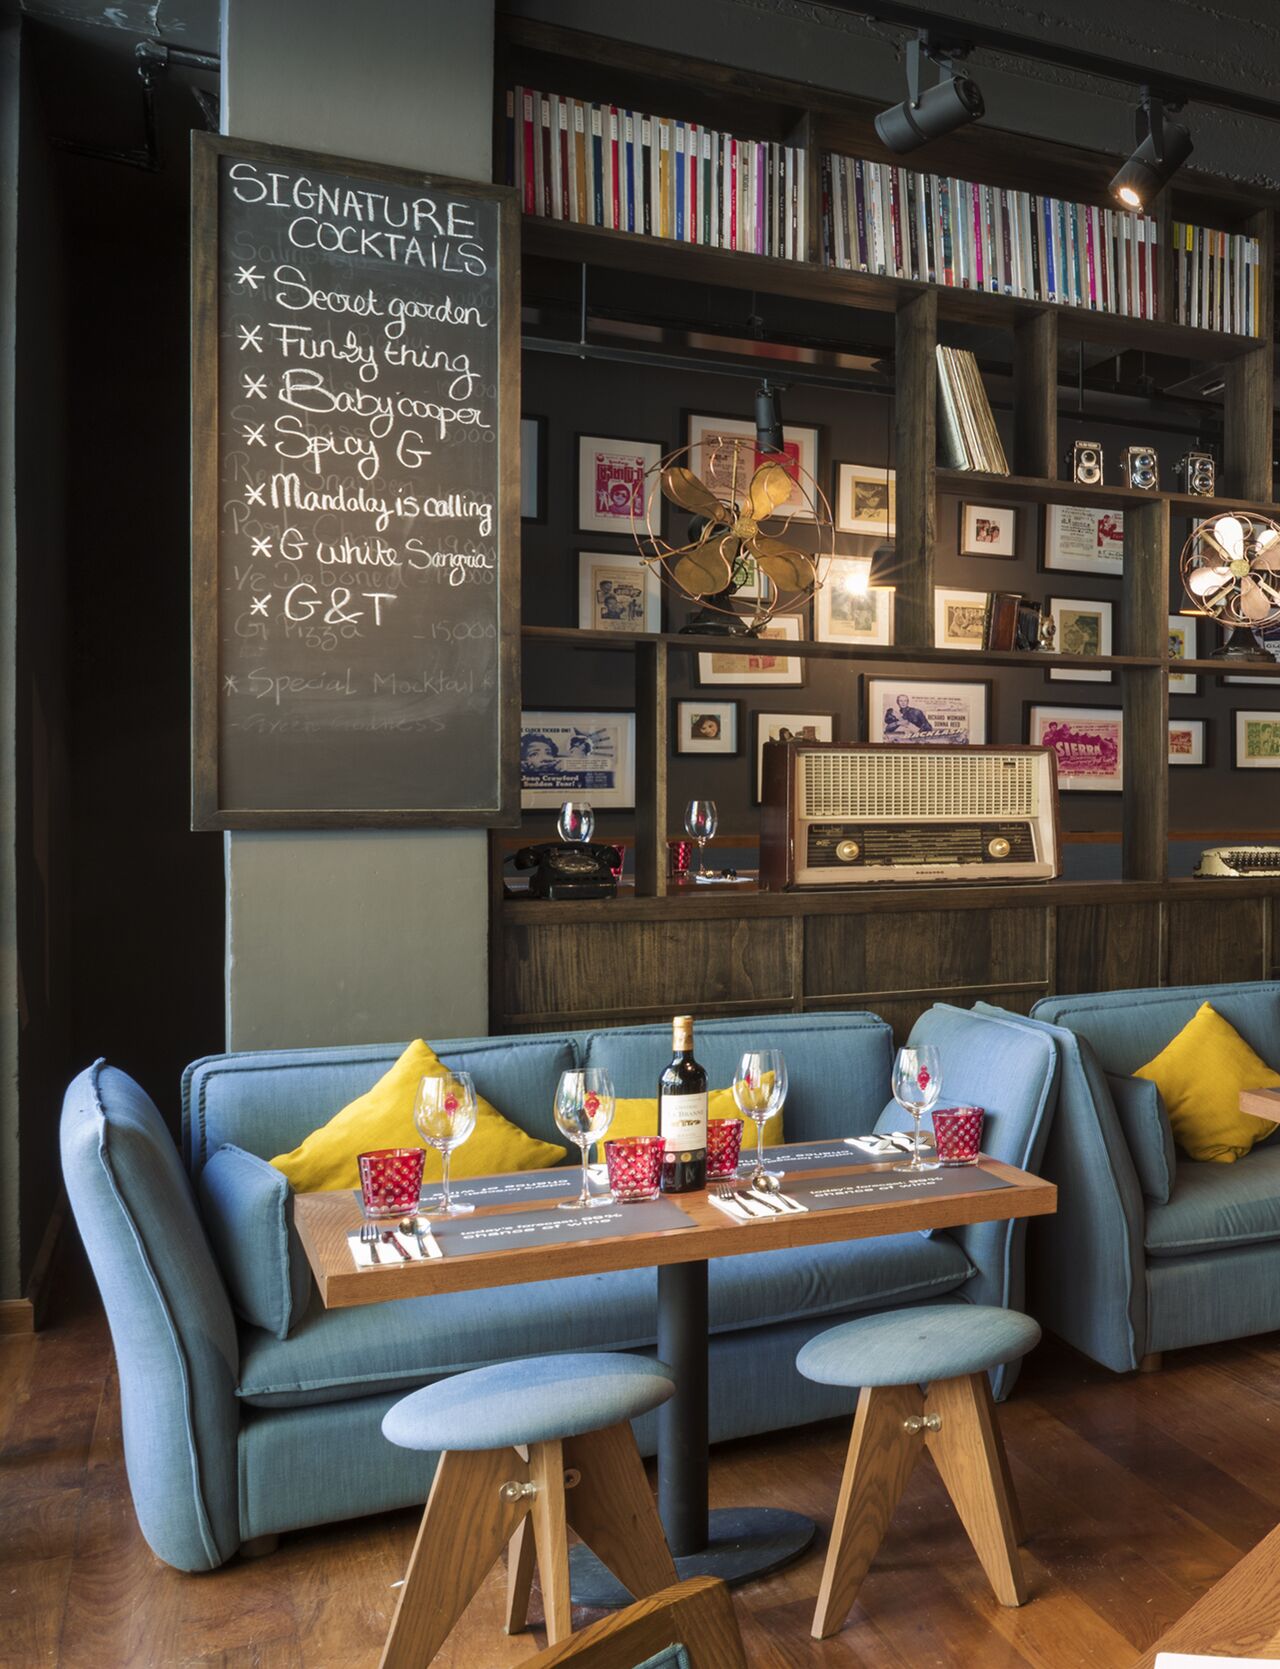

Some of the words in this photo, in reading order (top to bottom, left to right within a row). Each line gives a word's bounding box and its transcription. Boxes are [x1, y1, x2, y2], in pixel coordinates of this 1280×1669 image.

[229, 163, 475, 238] SIGNATURE
[288, 216, 487, 277] COCKTAILS
[273, 264, 384, 317] Secret
[384, 296, 488, 339] garden
[268, 322, 379, 383] Funky
[385, 342, 482, 401] thing
[278, 368, 394, 438] Baby
[398, 397, 491, 440] cooper
[274, 415, 380, 480] Spicy
[396, 430, 432, 469] G
[395, 488, 420, 518] is
[424, 494, 492, 536] calling
[280, 528, 309, 561] G
[316, 537, 403, 567] white
[405, 539, 494, 586] Sangria
[247, 667, 358, 706] Special
[1055, 741, 1103, 757] SIERRA
[462, 1227, 536, 1240] chance
[566, 1217, 612, 1228] wine
